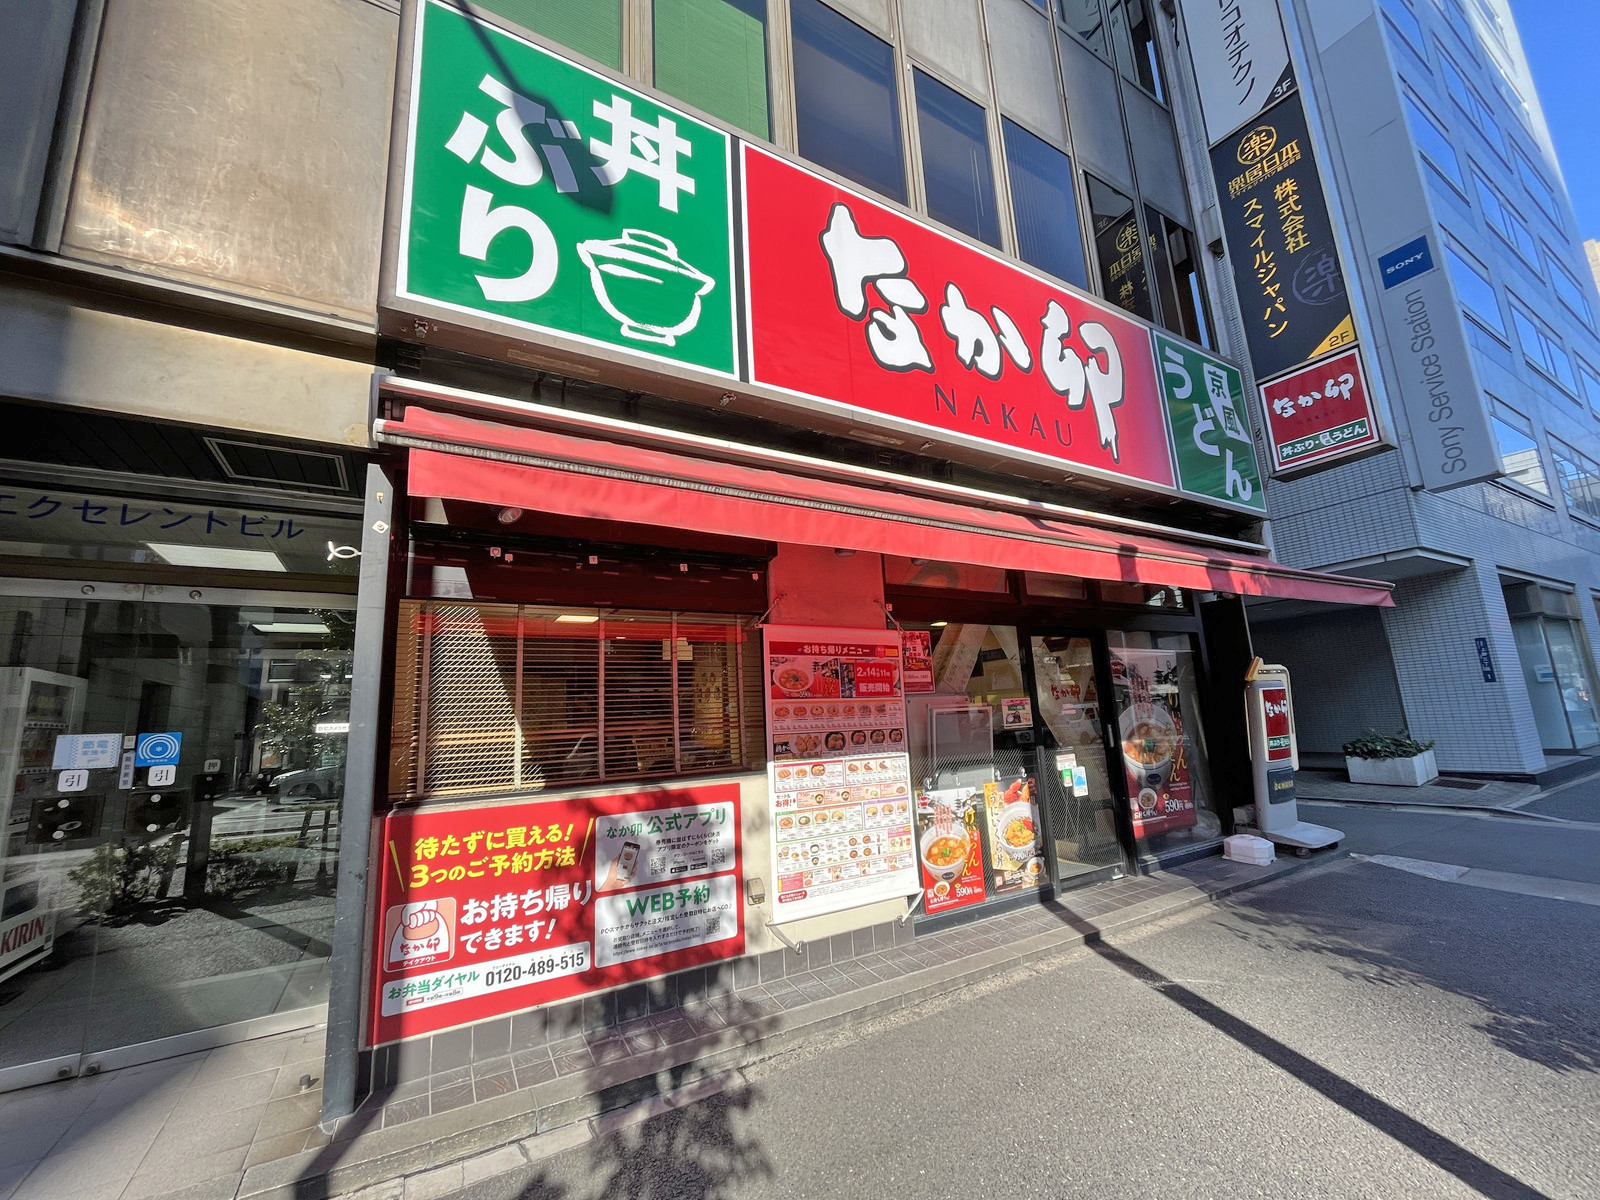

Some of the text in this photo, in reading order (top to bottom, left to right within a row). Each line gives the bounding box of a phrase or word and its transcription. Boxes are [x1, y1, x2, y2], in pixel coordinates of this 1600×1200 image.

[1273, 78, 1292, 97] 3F
[1228, 139, 1300, 192] 楽居日本
[1274, 178, 1310, 254] 株式会社
[1243, 198, 1288, 338] スマイルジャパン
[1386, 252, 1424, 275] SONY
[819, 202, 1124, 463] なか卯
[1328, 331, 1350, 347] 2F
[1272, 373, 1355, 418] なか卯
[1404, 289, 1467, 474] Sony Service Station
[935, 383, 1073, 447] NAKAU
[1208, 371, 1241, 436] 京風
[1163, 346, 1252, 501] うどん
[803, 645, 870, 655] お持ち帰りメニュー
[65, 774, 81, 787] 引
[154, 769, 169, 782] 引
[606, 823, 643, 839] なか卯
[647, 808, 727, 835] 公式アプリ
[414, 824, 574, 860] 待たずに買える!
[409, 845, 576, 888] 3つのご予約方法
[460, 880, 592, 926] お持ち帰り
[626, 885, 711, 917] WEB予約
[1, 914, 46, 956] KIRIN
[400, 938, 441, 956] なか卯
[460, 918, 556, 954] できます!
[402, 955, 436, 967] テイクアウト
[485, 952, 585, 987] 0120-489-515
[388, 971, 480, 1000] お弁当ダイヤル
